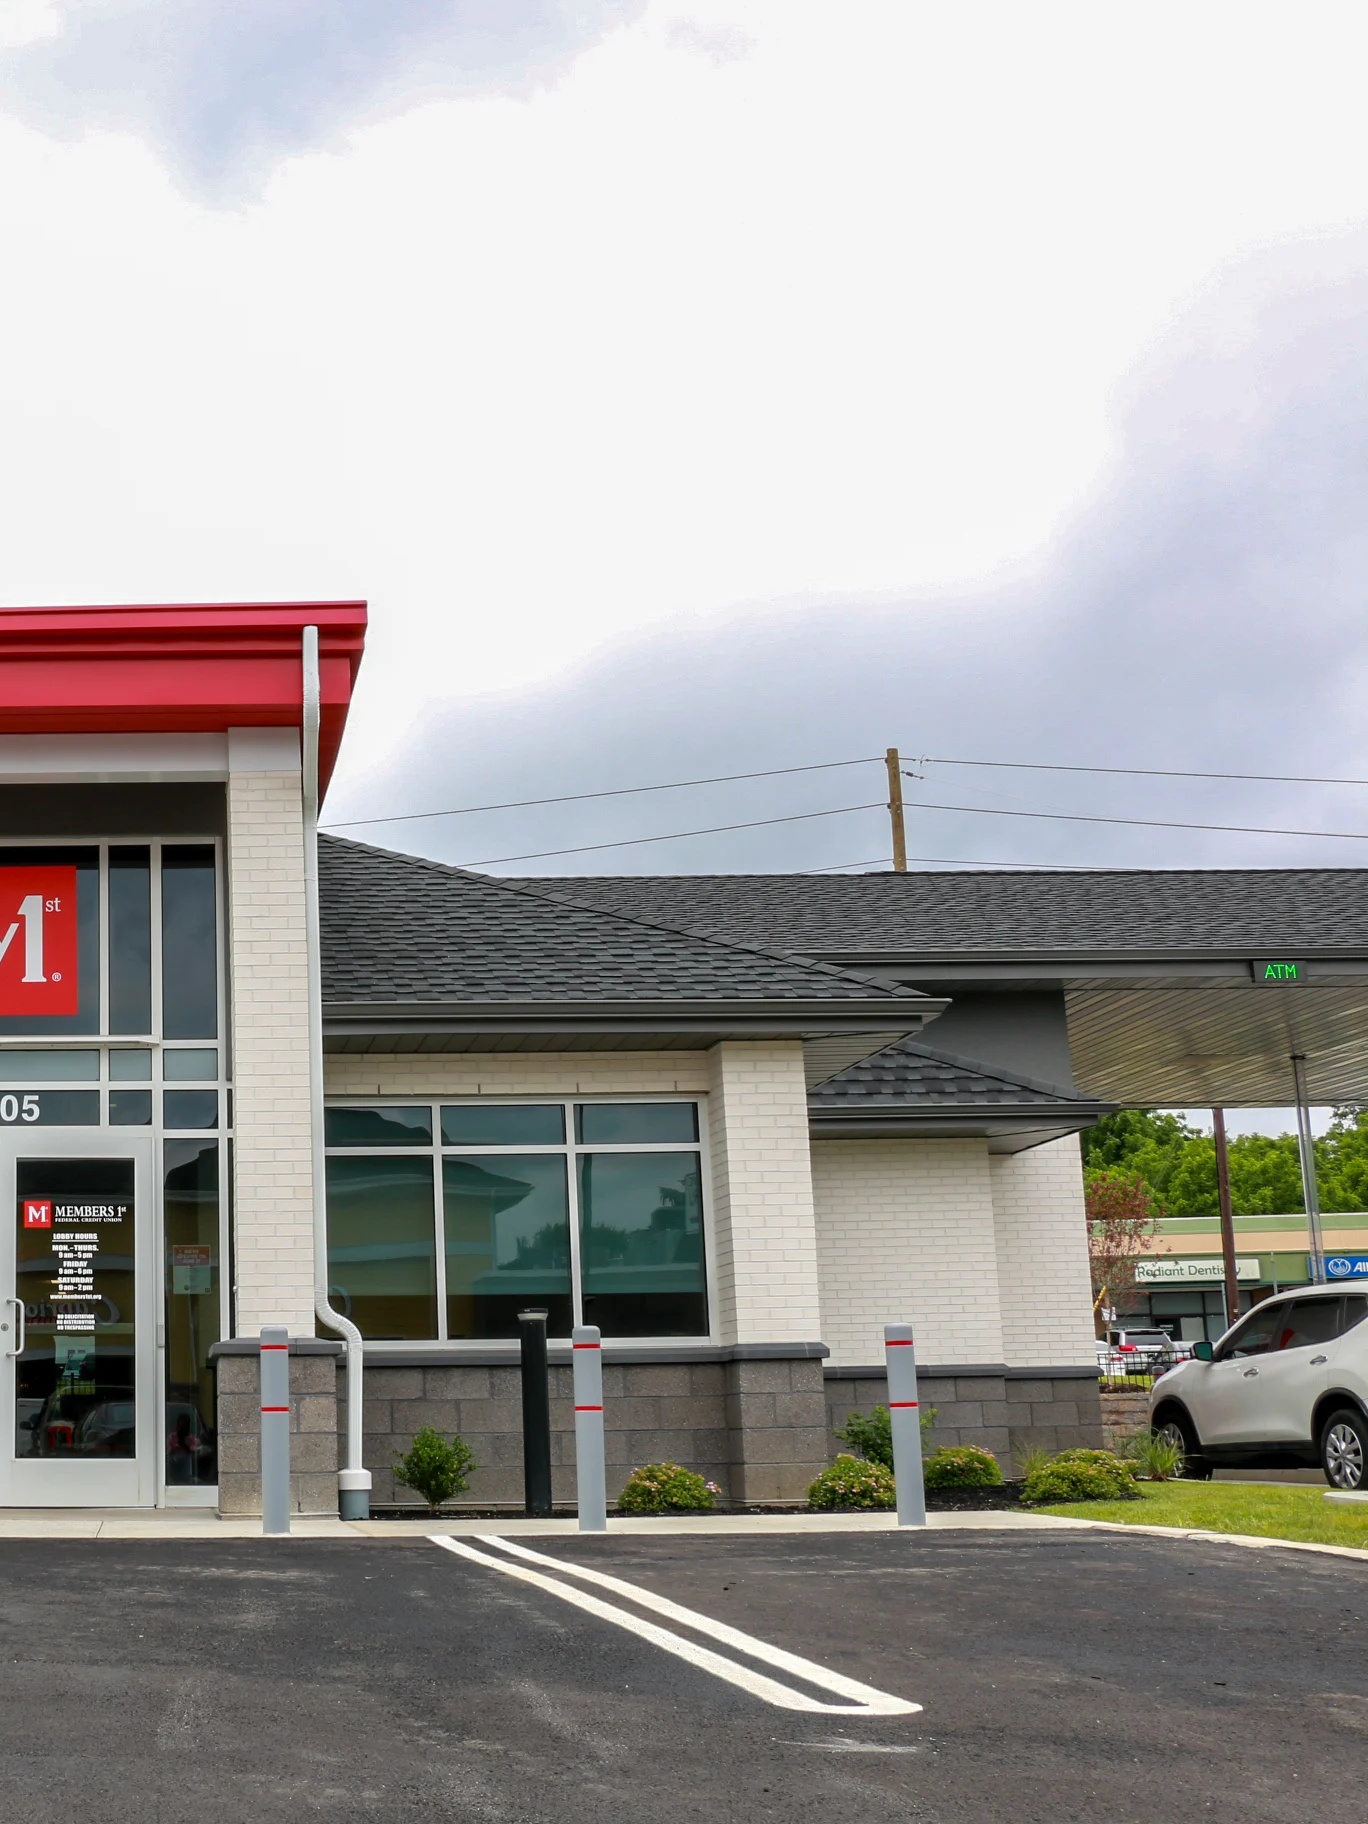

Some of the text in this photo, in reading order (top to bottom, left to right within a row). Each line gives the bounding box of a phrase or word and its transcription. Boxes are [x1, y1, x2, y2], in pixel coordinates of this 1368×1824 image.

[1264, 964, 1297, 979] ATM
[55, 1206, 114, 1217] MEMBERS
[1137, 1264, 1241, 1277] Radiant Dentisy
